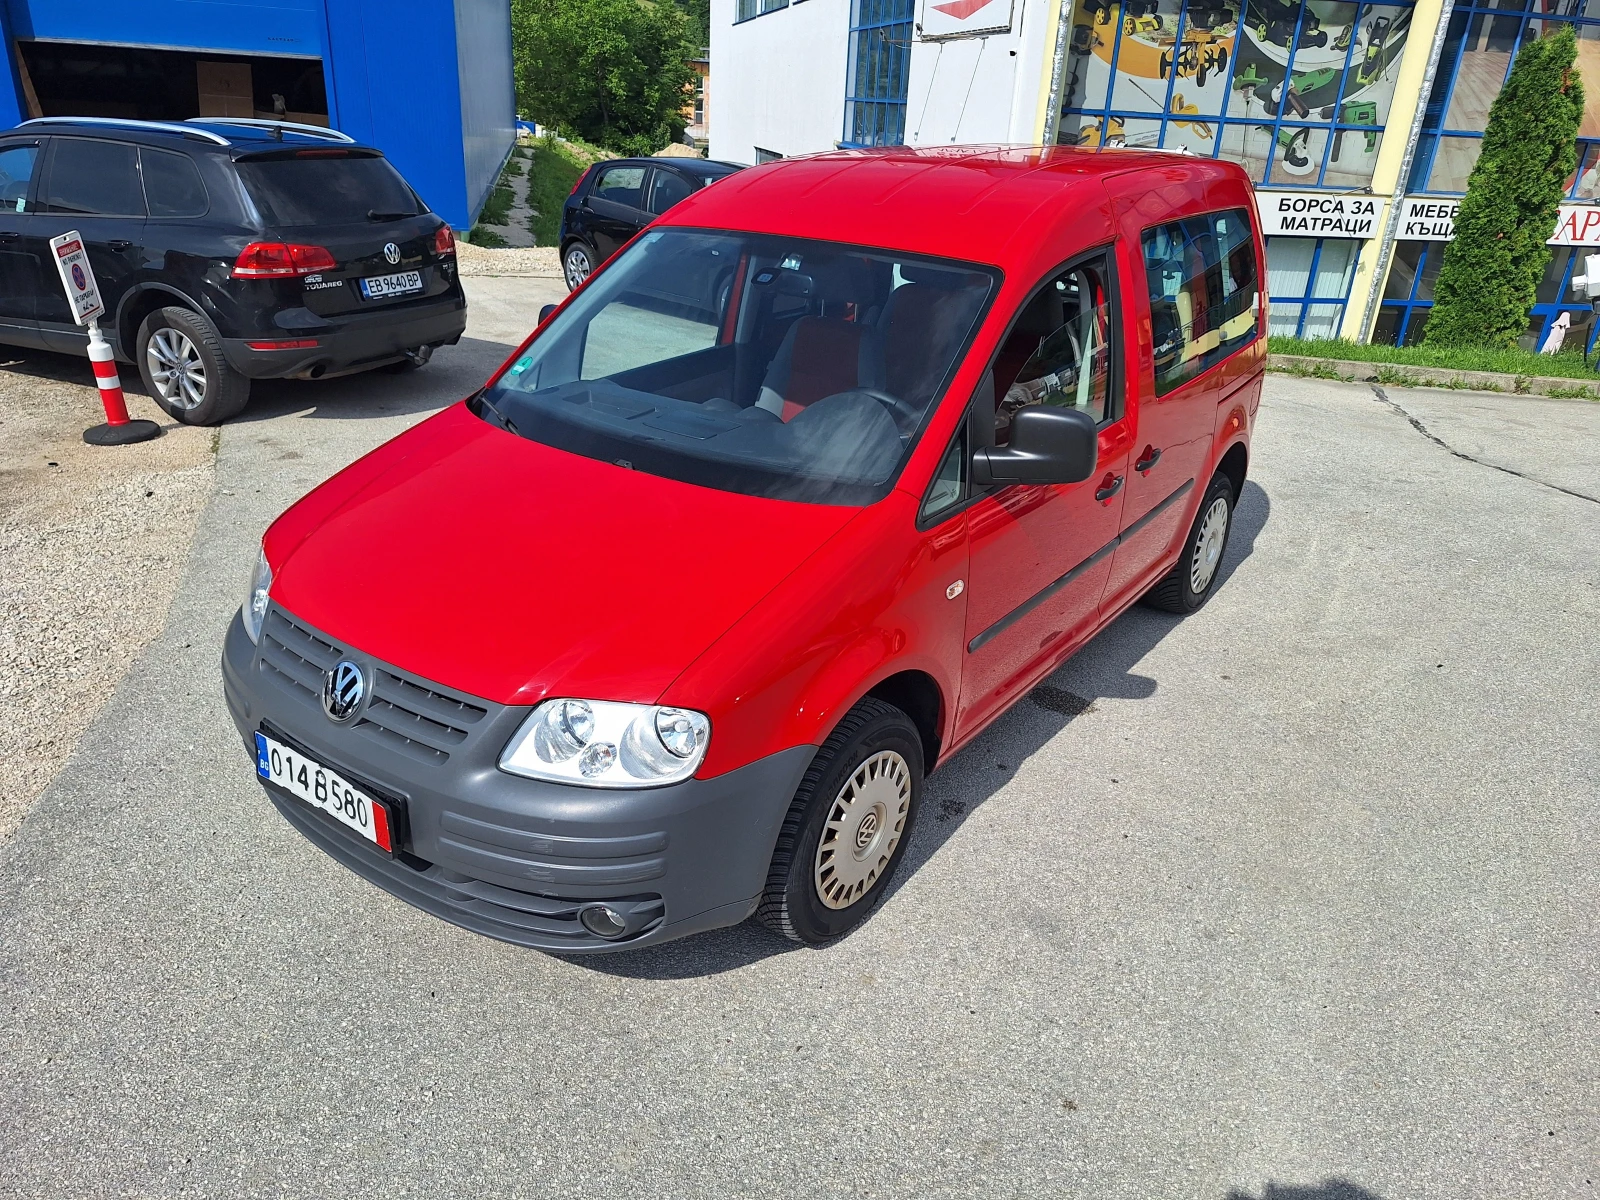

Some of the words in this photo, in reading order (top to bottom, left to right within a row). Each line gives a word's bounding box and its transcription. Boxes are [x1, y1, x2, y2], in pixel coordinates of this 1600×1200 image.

[1278, 198, 1345, 214] БОРСА
[1350, 201, 1375, 215] ЗА
[1410, 204, 1460, 218] МЕБЕ
[1280, 216, 1372, 235] МАТРАЦИ
[304, 280, 343, 291] TOUAREG
[368, 278, 384, 294] EB
[383, 275, 406, 291] 9640
[407, 273, 420, 288] BP
[260, 758, 269, 771] BG
